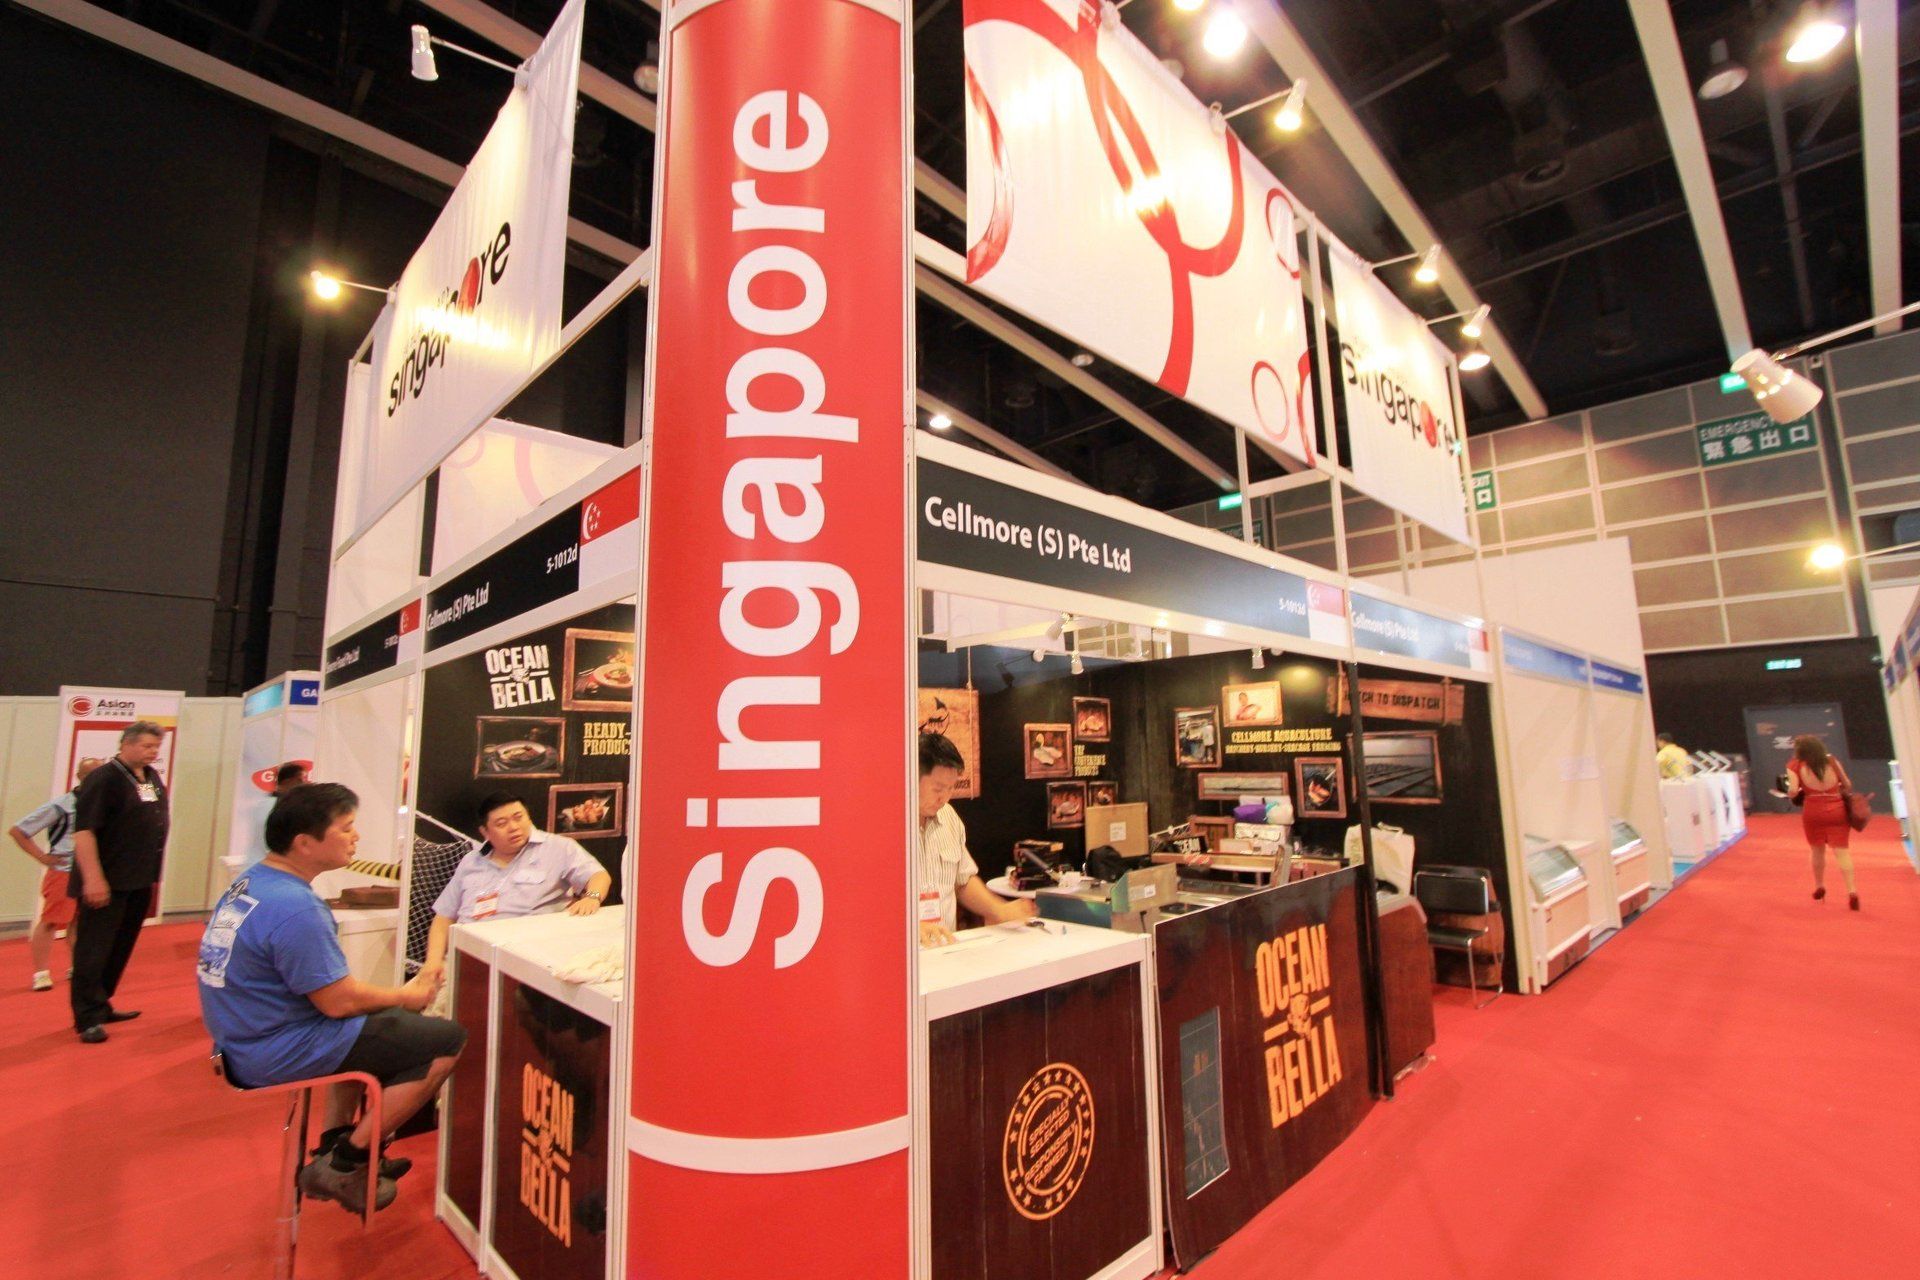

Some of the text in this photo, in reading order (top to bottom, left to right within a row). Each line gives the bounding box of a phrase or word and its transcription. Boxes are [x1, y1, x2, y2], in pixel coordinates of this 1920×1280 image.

[682, 90, 860, 970] Singapore
[925, 496, 1131, 573] Cellmore (S) Pte Ltd
[427, 607, 452, 631] Cellmore
[463, 593, 475, 614] Pte
[476, 581, 490, 608] Ltd
[485, 645, 550, 675] OCEAN
[97, 699, 135, 709] Asian
[490, 677, 556, 710] BELLA
[1378, 693, 1388, 705] TO
[1392, 695, 1440, 709] DISPATCH
[1256, 923, 1330, 1019] OCEAN
[1264, 1014, 1342, 1129] BELLA
[522, 1062, 574, 1157] OCEAN
[1029, 1095, 1070, 1146] SPECIALLY
[1030, 1109, 1070, 1159] SELECTED
[1024, 1119, 1077, 1184] RESPONSIBLY
[520, 1141, 572, 1248] BELLA
